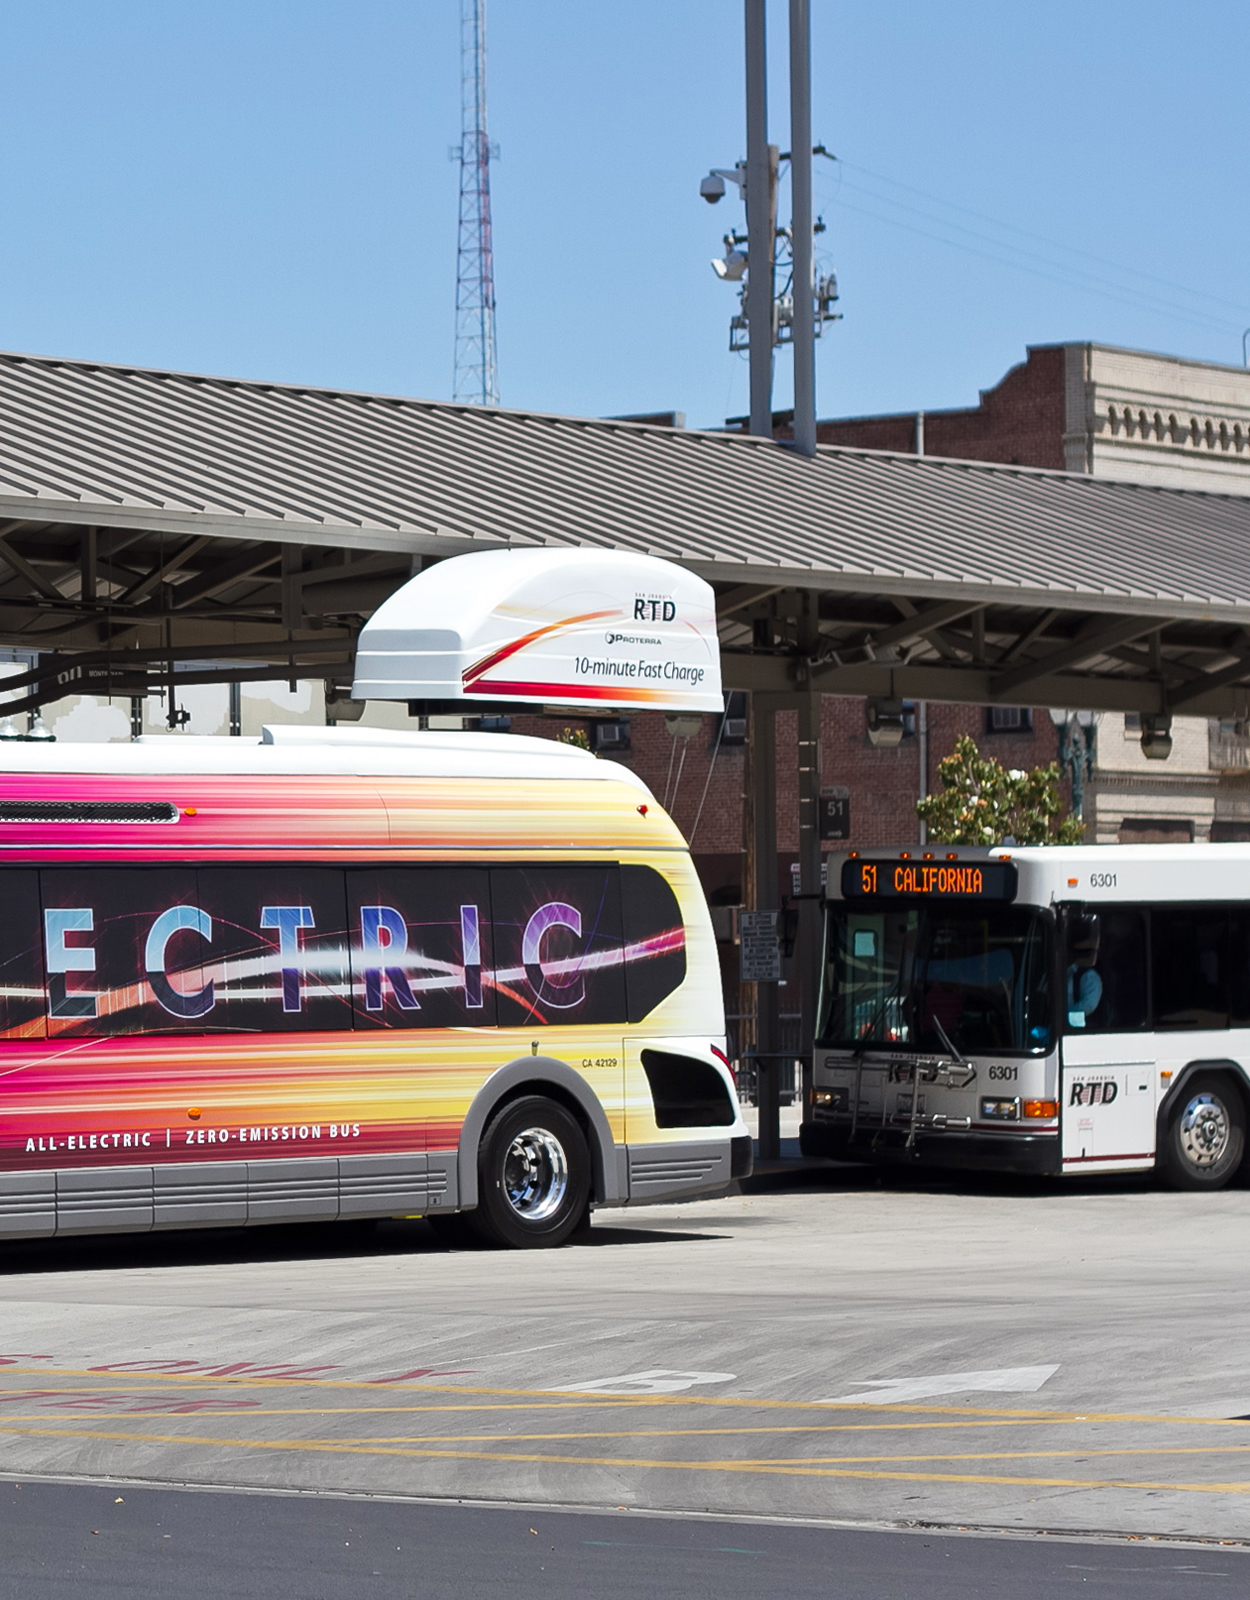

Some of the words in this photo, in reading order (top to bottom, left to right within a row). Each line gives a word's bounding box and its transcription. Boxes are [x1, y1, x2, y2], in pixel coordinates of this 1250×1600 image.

[634, 599, 676, 622] RTD
[575, 657, 636, 677] 10-minute
[638, 660, 662, 678] Fast
[664, 662, 704, 685] Charge
[828, 801, 843, 816] 51
[862, 865, 877, 893] 51
[894, 868, 983, 893] CALIFORNIA
[1090, 873, 1117, 888] 6301
[582, 1059, 593, 1068] CA
[595, 1058, 618, 1067] 42129
[989, 1066, 1019, 1081] 6301
[1068, 1082, 1118, 1107] RTD
[26, 1132, 151, 1152] ALL-ELECTRIC
[186, 1125, 322, 1145] ZERO-EMISSION
[329, 1123, 361, 1138] BUS
[87, 1360, 480, 1384] ONLY
